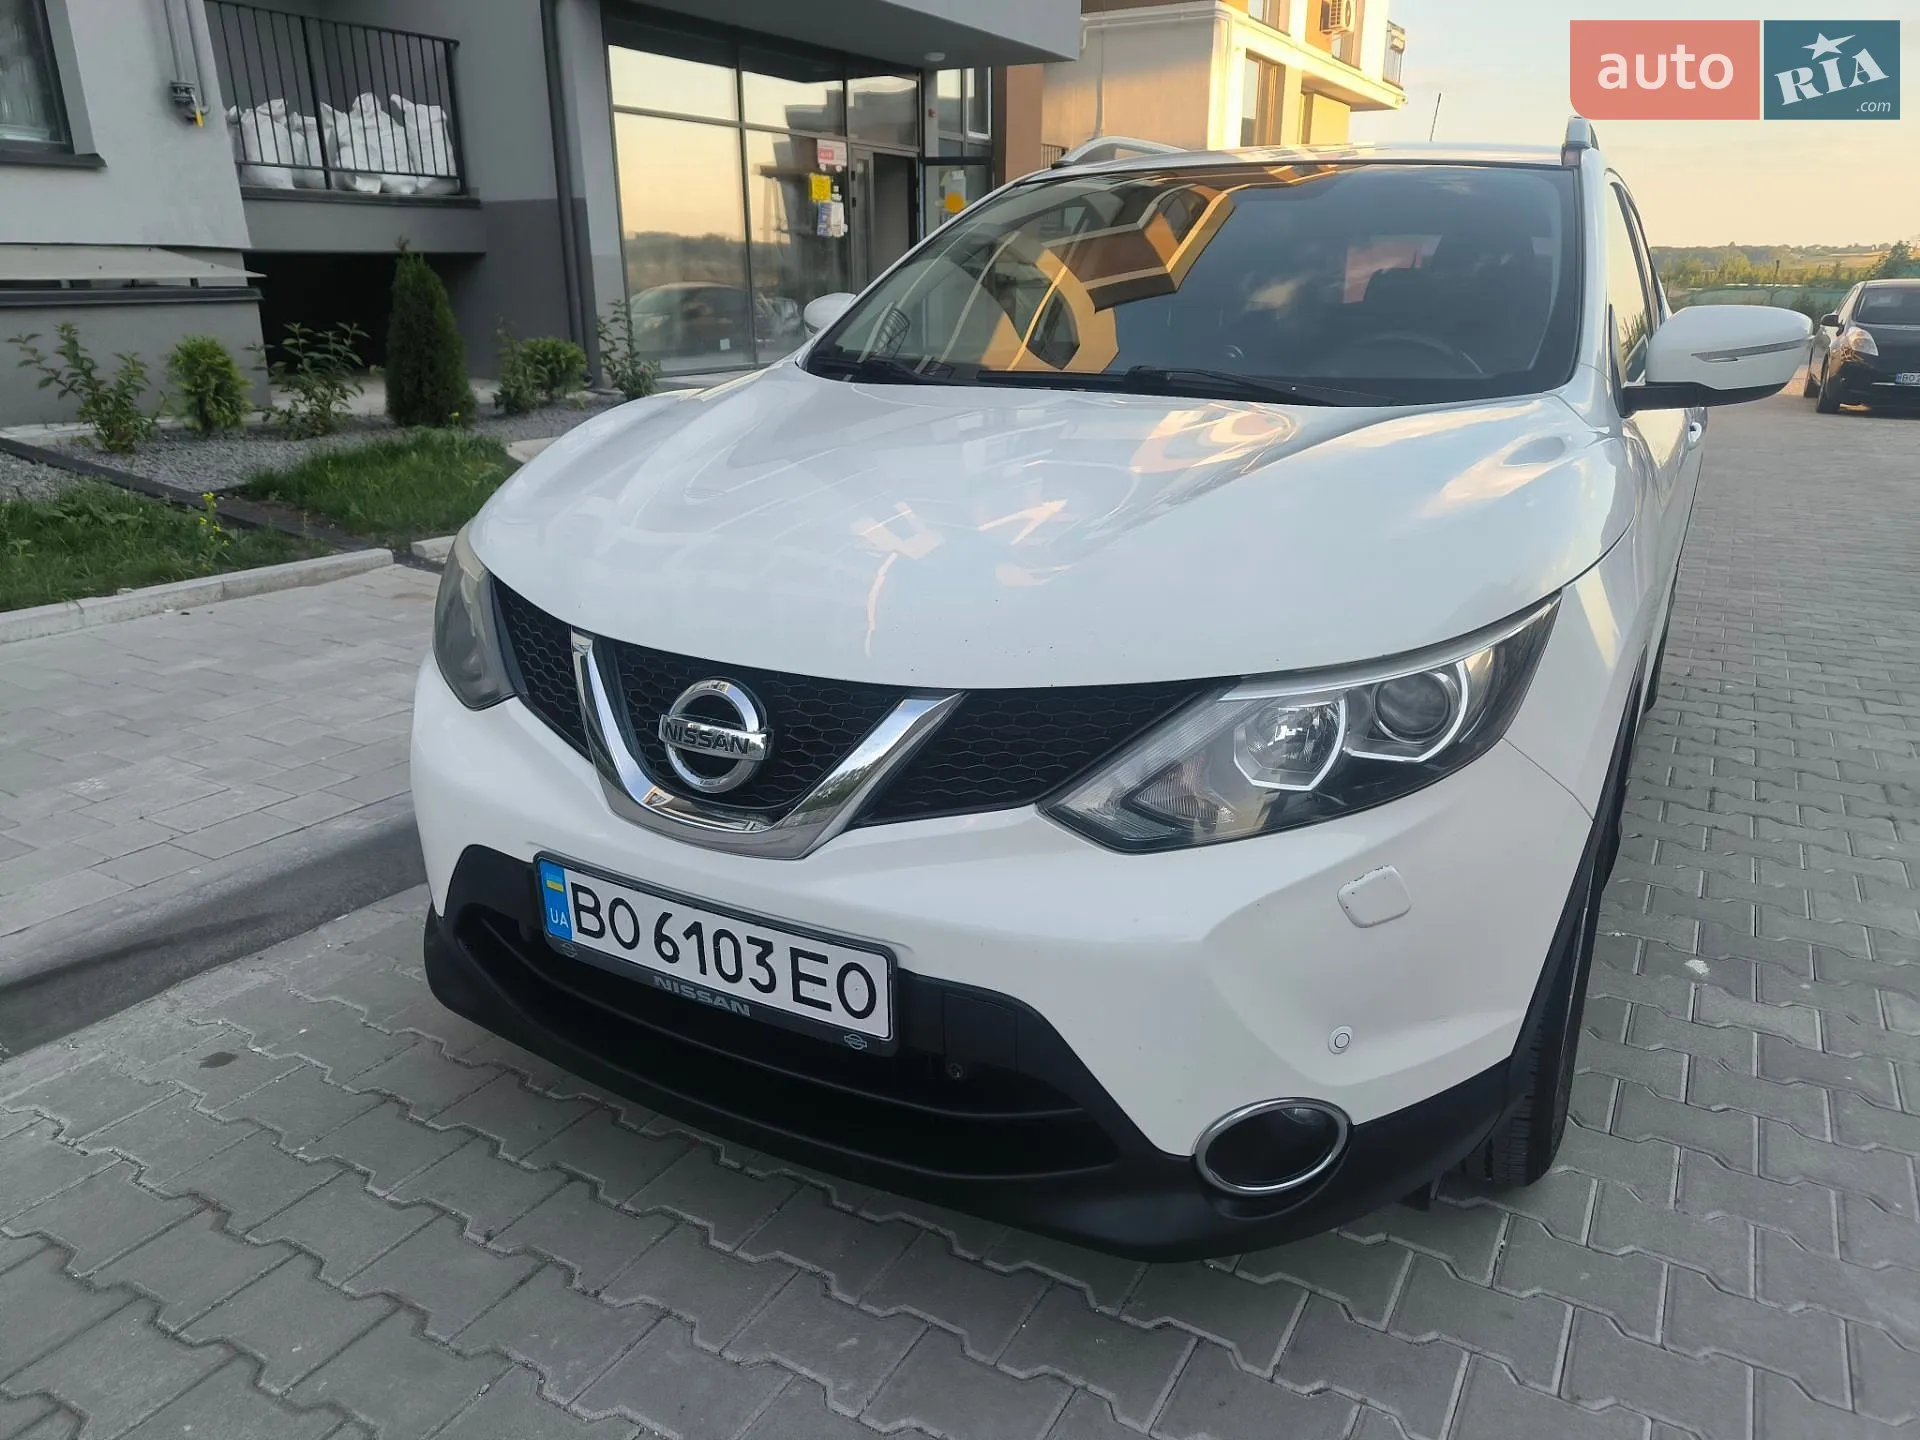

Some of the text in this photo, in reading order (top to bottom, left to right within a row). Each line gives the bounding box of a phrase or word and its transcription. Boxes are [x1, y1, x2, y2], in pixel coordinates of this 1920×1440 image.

[661, 721, 750, 755] NISSAN
[549, 907, 569, 928] UA
[570, 881, 877, 1020] BO 6103 EO
[653, 974, 751, 1018] NISSAN
